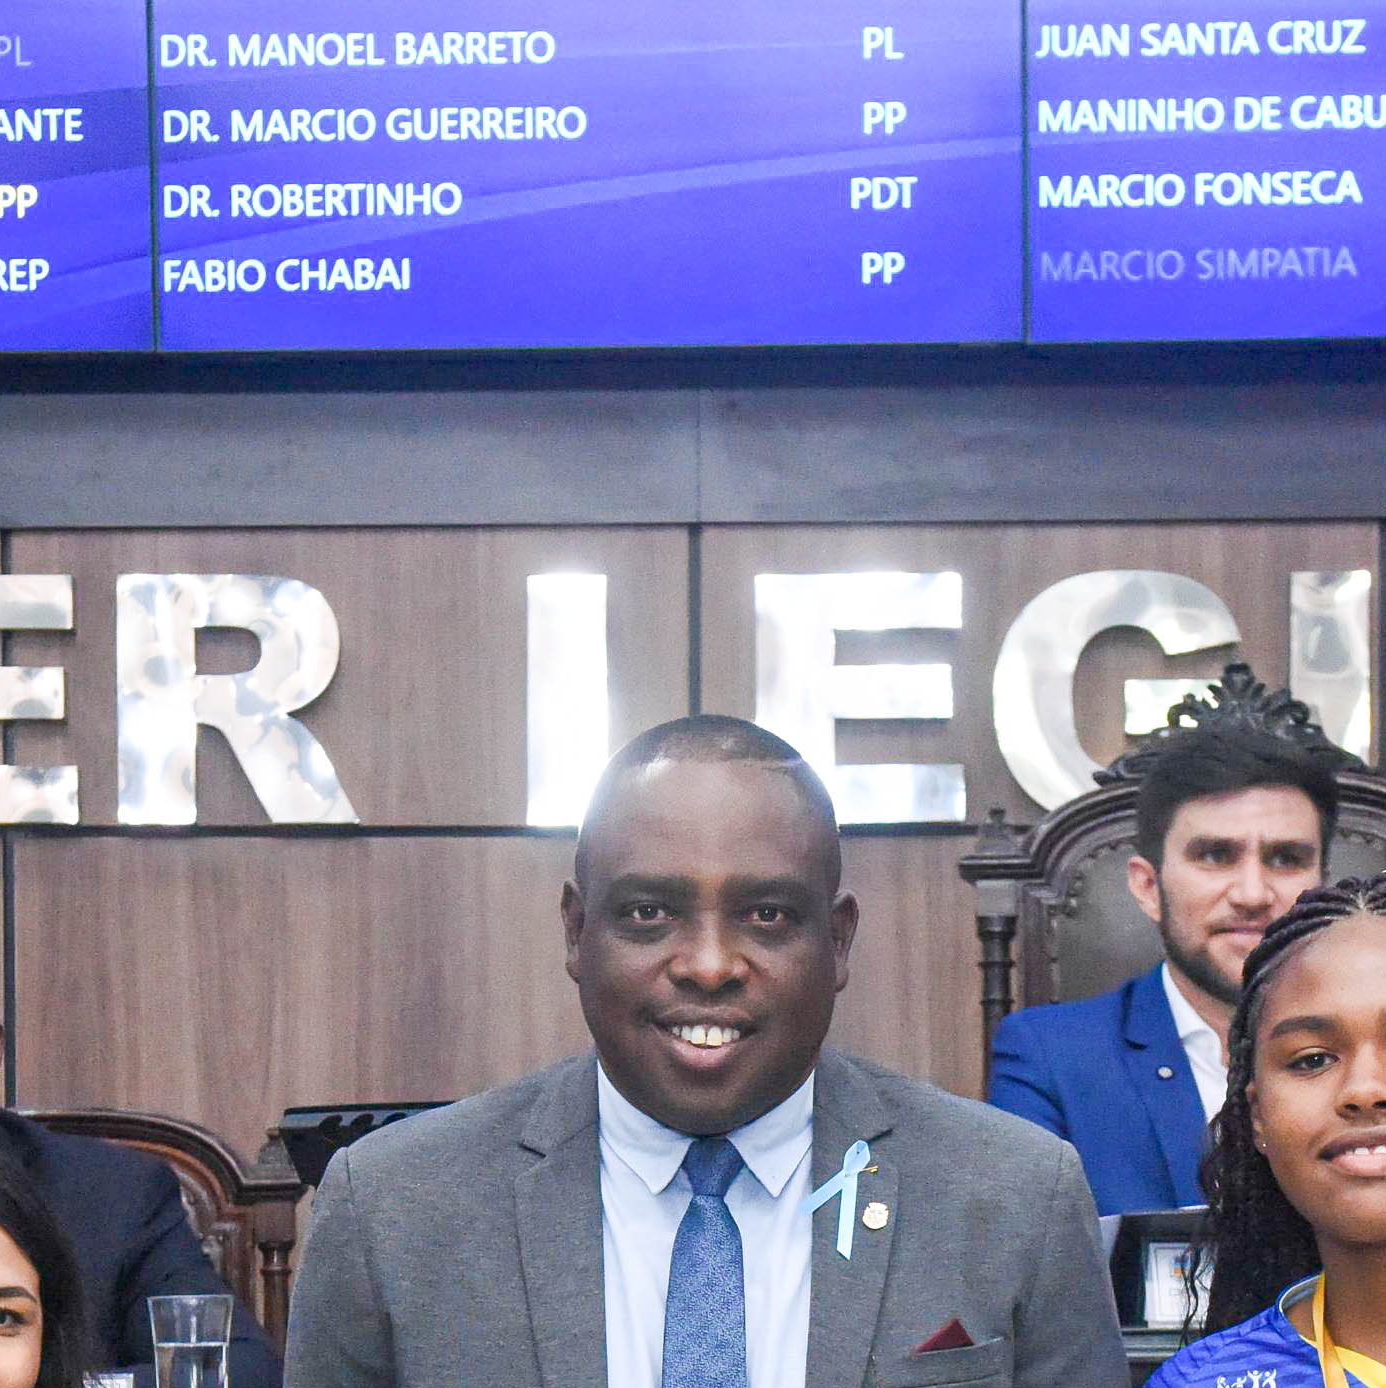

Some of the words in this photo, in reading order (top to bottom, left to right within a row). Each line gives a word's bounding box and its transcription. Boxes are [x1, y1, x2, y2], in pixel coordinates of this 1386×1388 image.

[160, 33, 217, 68] DR.
[228, 32, 386, 67] MANOEL
[395, 30, 556, 65] BARRETO
[862, 26, 905, 60] PL
[1035, 23, 1130, 58] JUAN
[1140, 21, 1260, 57] SANTA
[1267, 18, 1367, 55] CRUZ
[163, 109, 220, 143] DR.
[230, 108, 377, 142] MARCIO
[385, 105, 587, 141] GUERREIRO
[863, 101, 907, 135] PP
[1038, 97, 1225, 133] MANINHO
[1234, 95, 1283, 131] DE
[163, 184, 220, 218] DR.
[230, 182, 463, 217] ROBERTINHO
[850, 176, 918, 210] PDT
[1038, 173, 1186, 208] MARCIO
[1194, 169, 1364, 206] FONSECA
[163, 258, 267, 293] FABIO
[275, 257, 411, 292] CHABAI
[861, 251, 906, 285] PP
[1041, 247, 1187, 282] MARCIO
[1195, 245, 1358, 281] SIMPATIA
